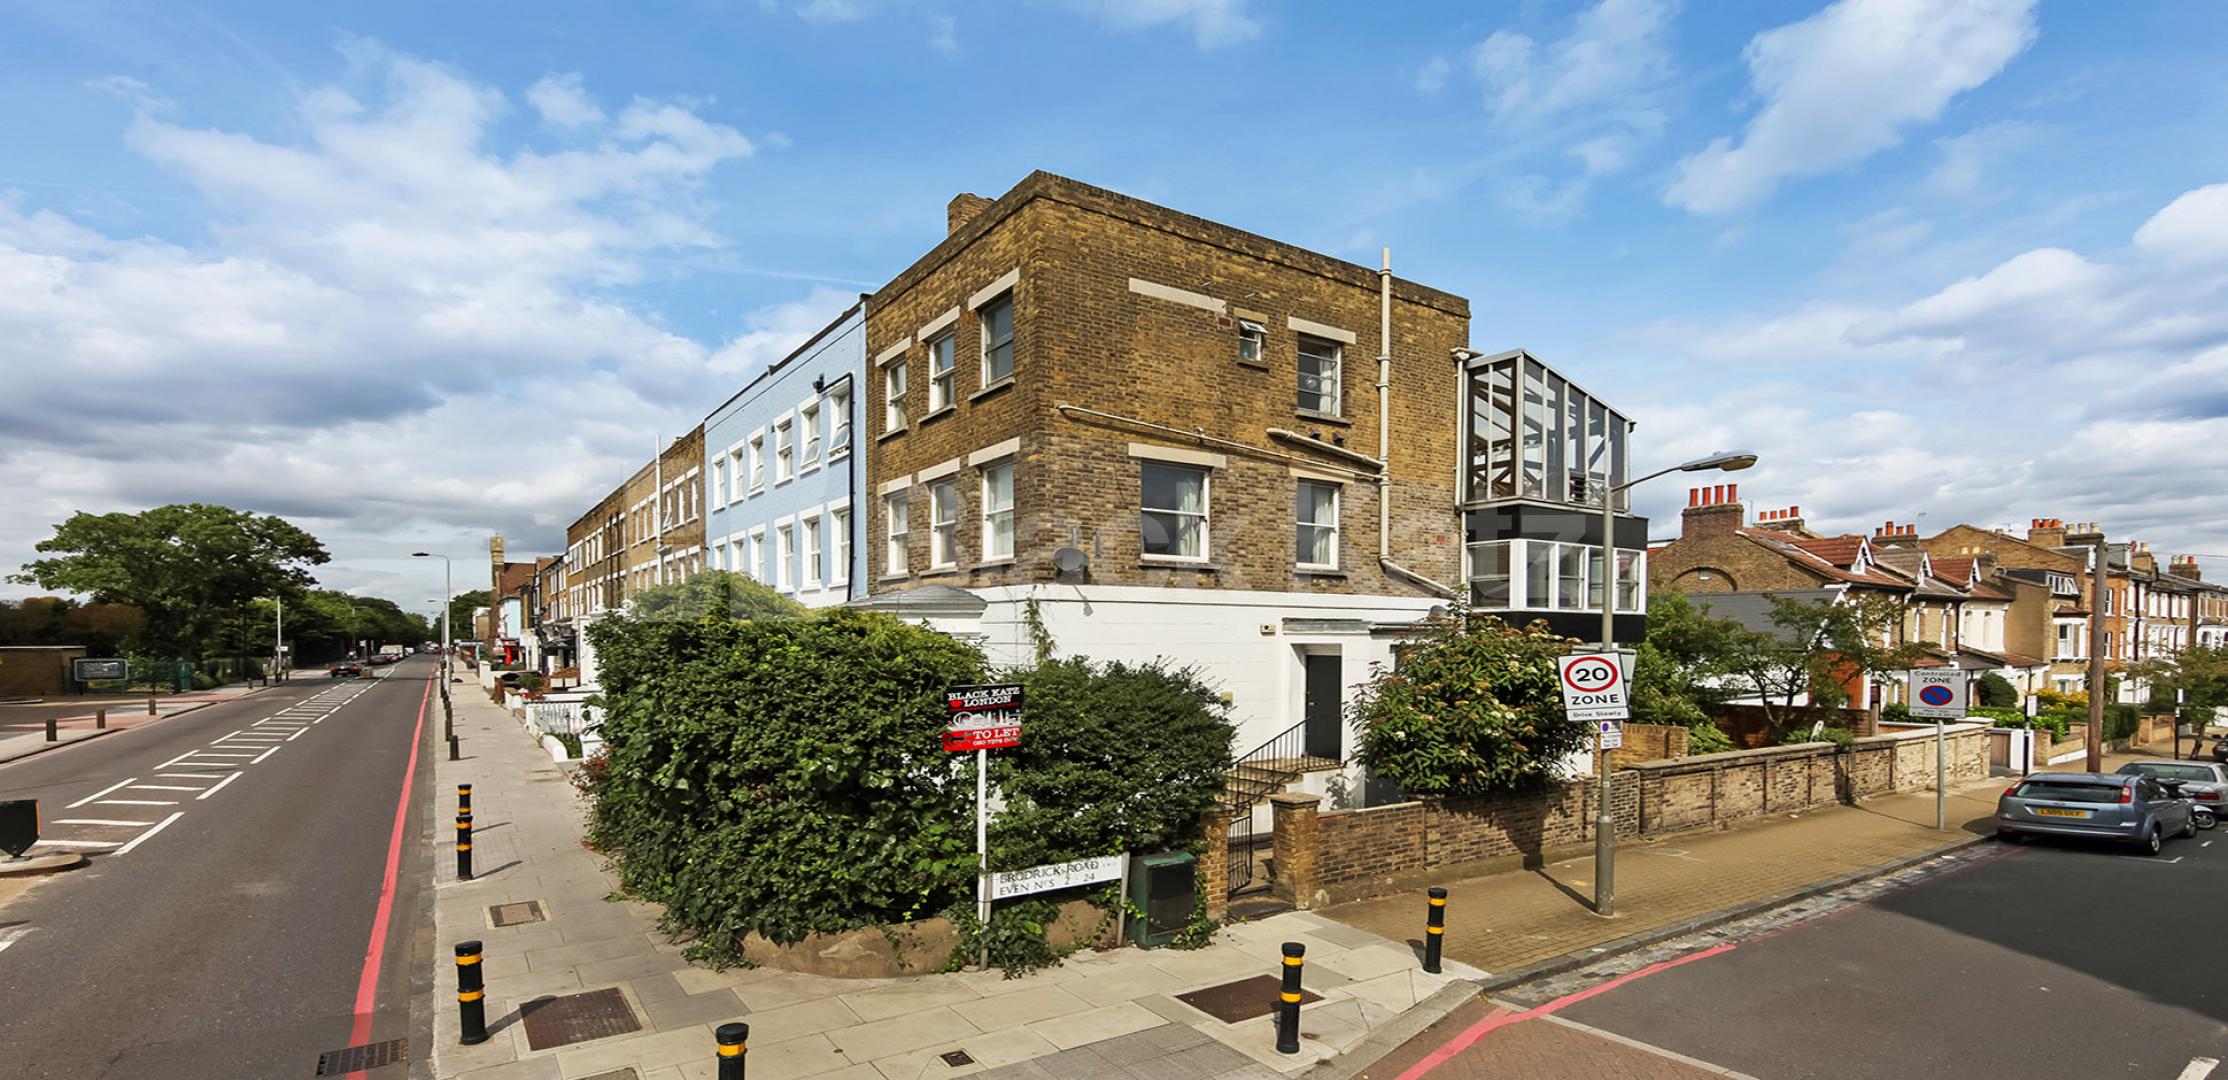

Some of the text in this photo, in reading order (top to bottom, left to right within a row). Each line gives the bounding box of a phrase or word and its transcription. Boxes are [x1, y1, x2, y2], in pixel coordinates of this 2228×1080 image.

[1575, 667, 1609, 682] 20
[948, 687, 1020, 700] BLACK KATZ
[1571, 694, 1620, 705] ZONE
[963, 696, 1012, 707] LONDON
[972, 730, 992, 740] TO
[994, 728, 1020, 738] LET
[1000, 866, 1061, 884] BRODRICK
[1066, 860, 1099, 874] ROAD
[1000, 883, 1029, 895] EVEN
[1064, 876, 1071, 885] 2
[1083, 872, 1096, 881] 24
